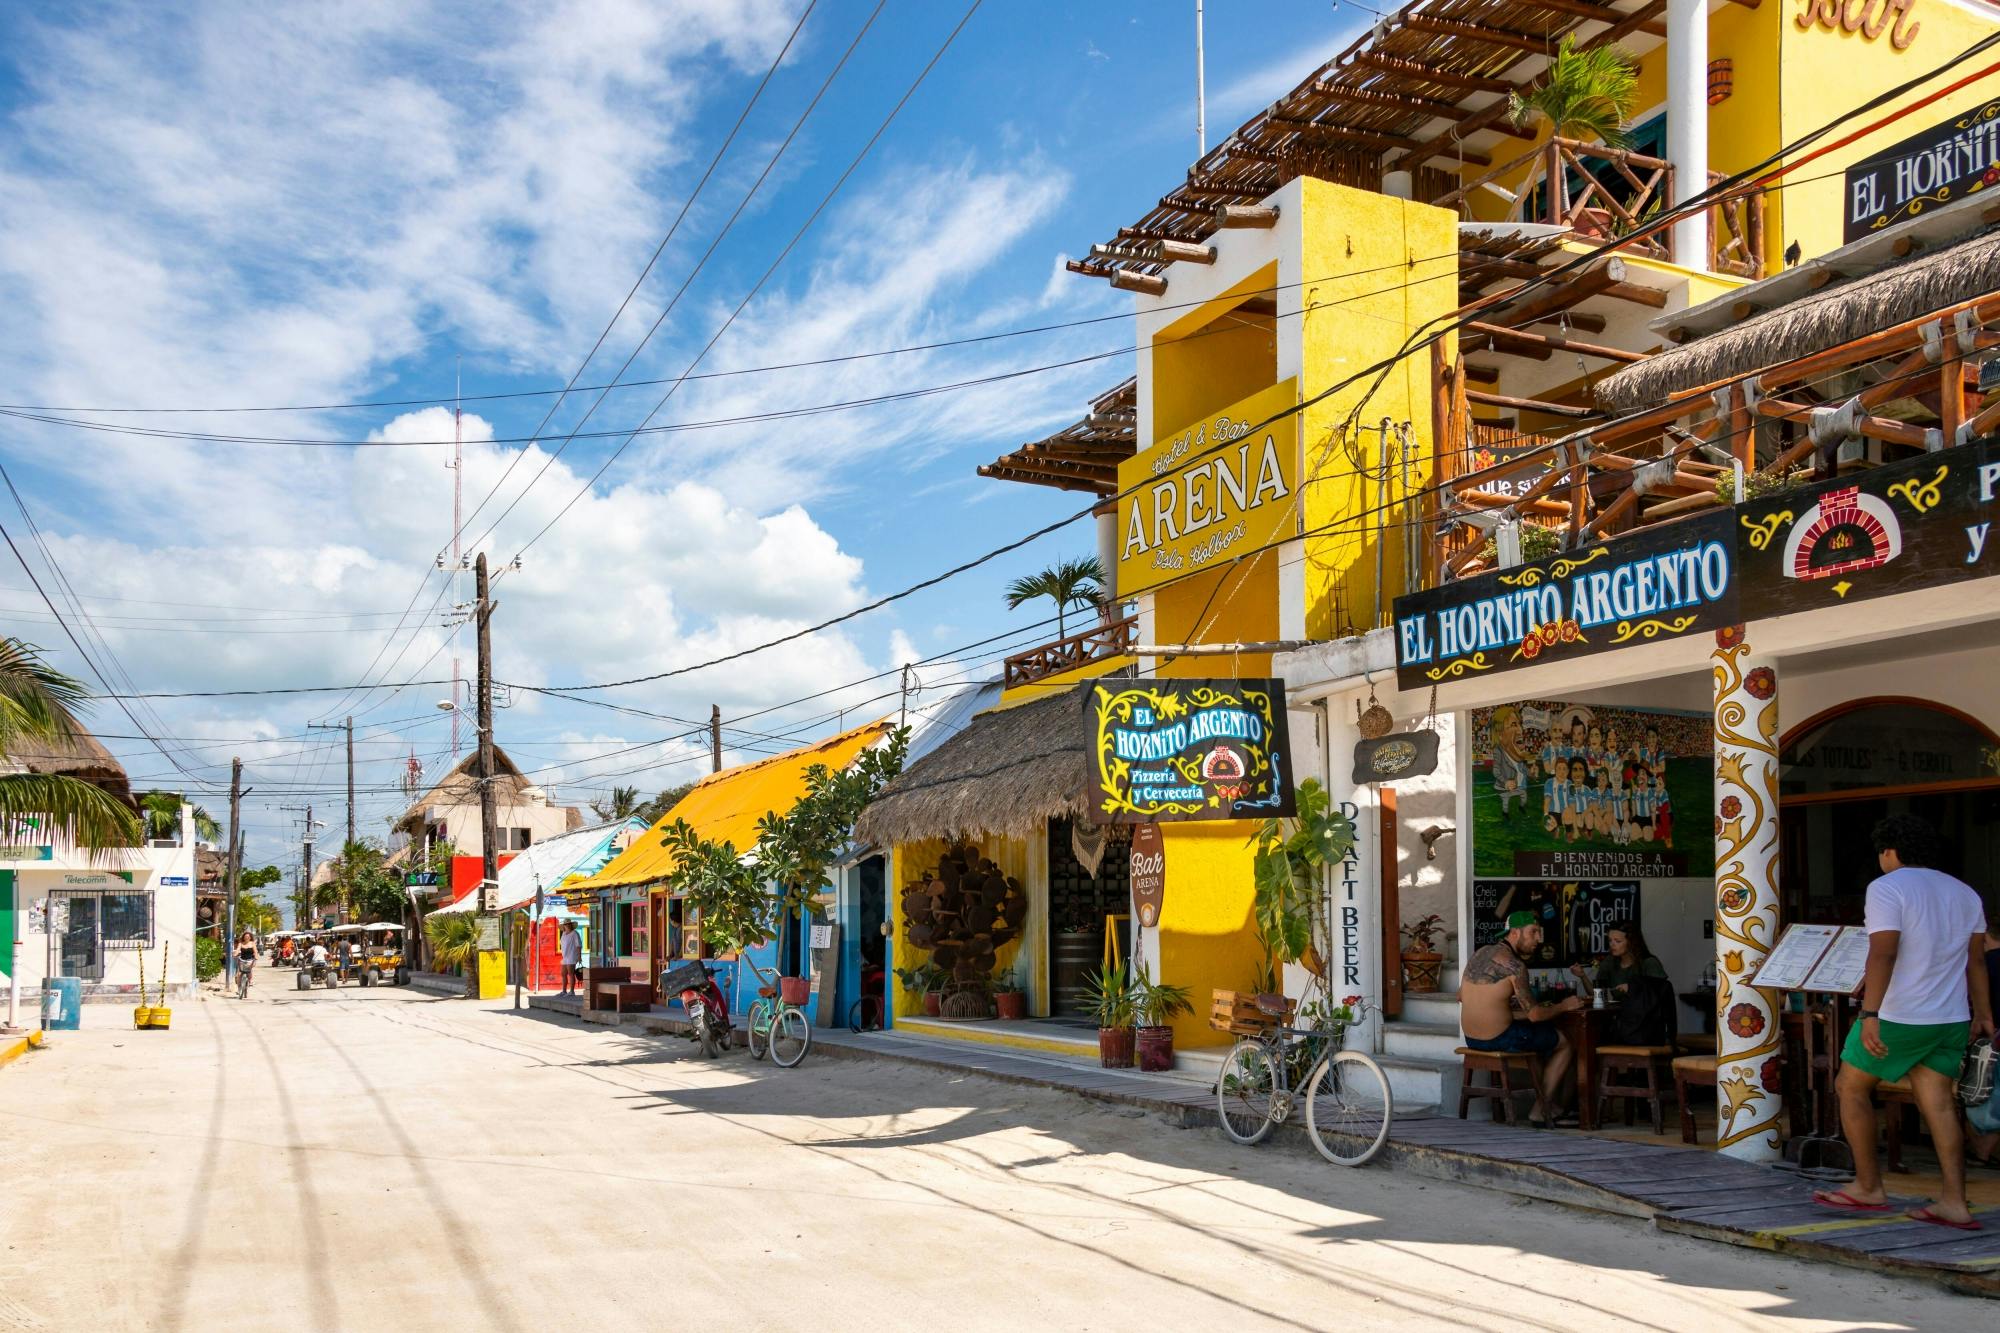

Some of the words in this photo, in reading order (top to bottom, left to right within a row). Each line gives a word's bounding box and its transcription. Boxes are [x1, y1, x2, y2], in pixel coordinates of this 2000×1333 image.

[1851, 172, 1886, 223] EL
[1152, 431, 1191, 474] Hotel
[1196, 423, 1205, 445] &
[1212, 417, 1249, 440] Bar
[1122, 434, 1289, 561] ARENA
[1152, 549, 1184, 569] Isla
[1189, 520, 1246, 567] Holbox
[1400, 614, 1434, 664] EL
[1572, 542, 1728, 626] ARGENTO
[1134, 708, 1155, 726] EL
[1115, 722, 1188, 760] HORNiTO
[1189, 710, 1261, 744] ARGENTO
[1130, 768, 1176, 784] Pizzería
[1133, 788, 1142, 804] y
[1143, 782, 1204, 800] Cervecería
[1131, 852, 1163, 876] Bar
[1541, 863, 1559, 877] EL
[1622, 865, 1674, 877] ARGENTO
[1655, 853, 1662, 863] A
[65, 875, 106, 884] Telecomm
[1136, 876, 1159, 889] ARENA
[1474, 884, 1497, 897] Chela
[1589, 897, 1629, 923] Craft
[1341, 906, 1360, 986] BEER
